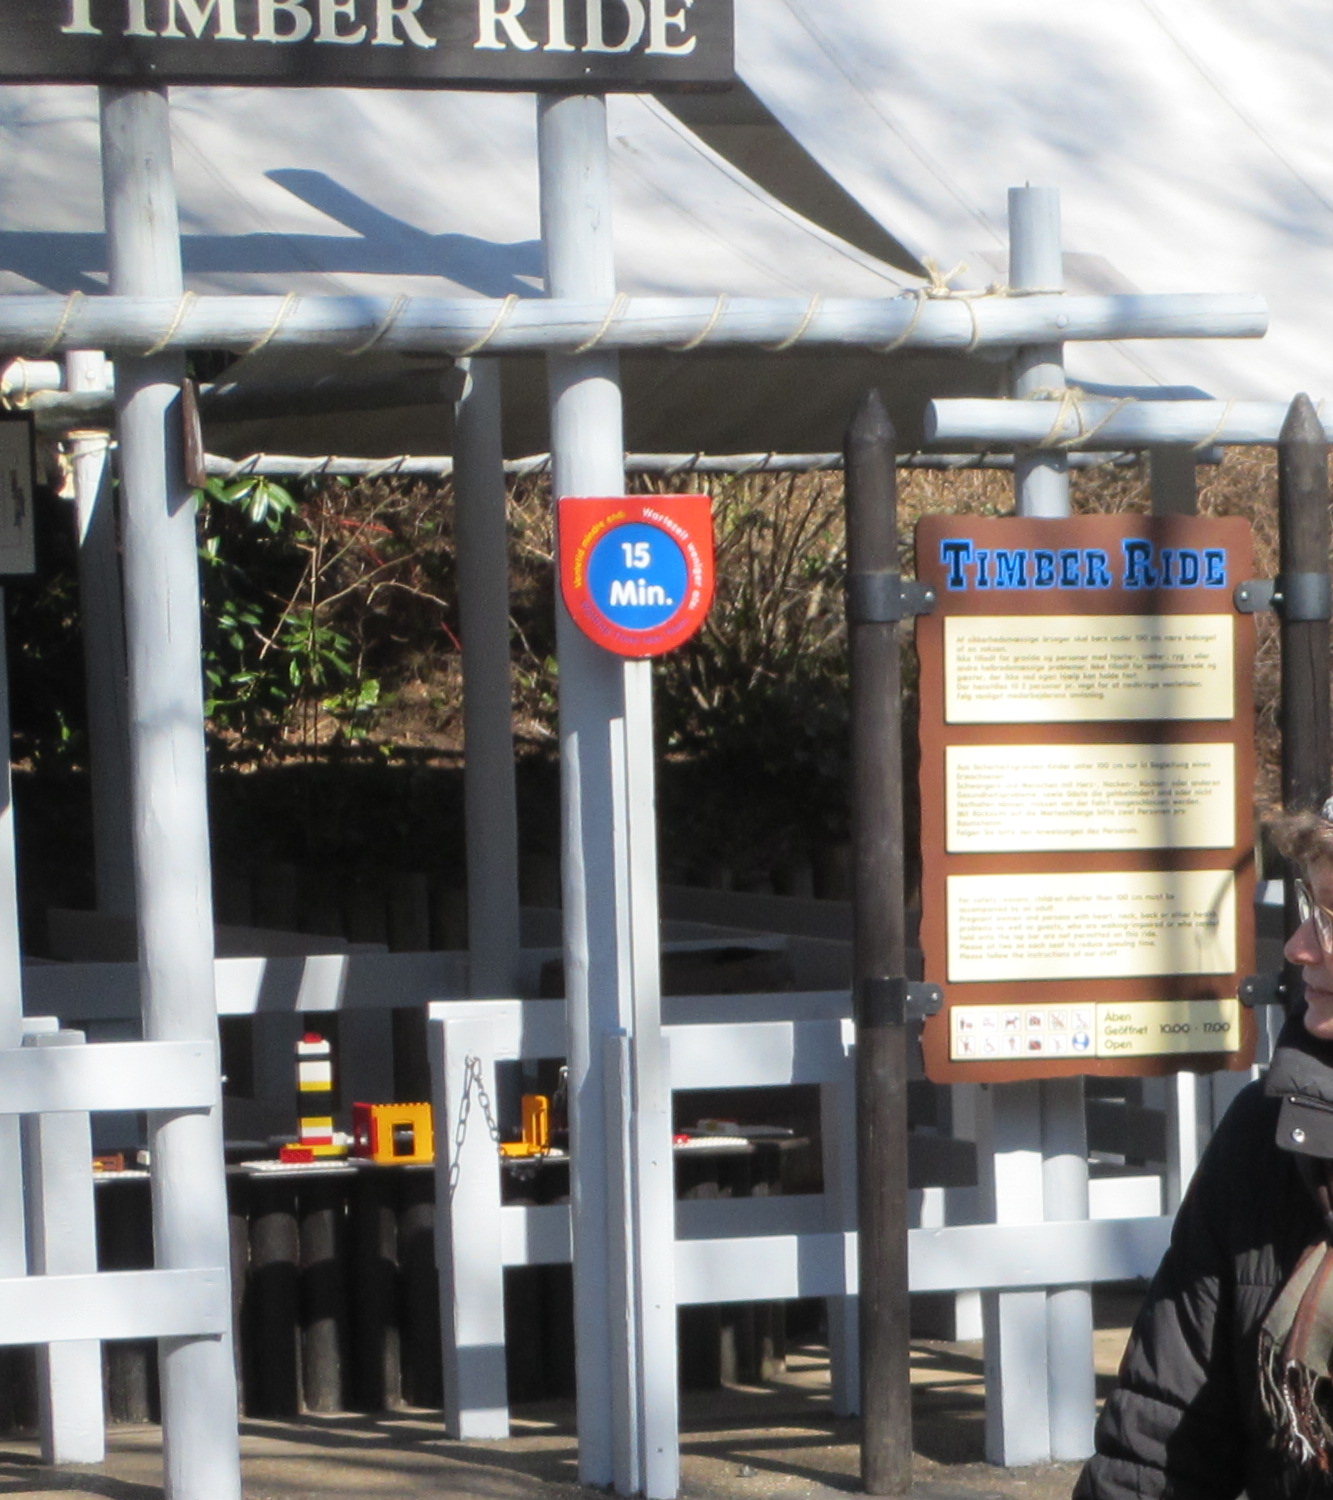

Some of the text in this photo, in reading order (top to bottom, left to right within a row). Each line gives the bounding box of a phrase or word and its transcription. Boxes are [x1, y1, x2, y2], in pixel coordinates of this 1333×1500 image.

[473, 0, 697, 54] RIDE
[621, 541, 651, 569] 15
[642, 507, 690, 541] Wartezeit
[687, 542, 703, 587] weniger
[941, 538, 1227, 590] TIMBER RIDE
[610, 577, 674, 607] Min.
[1104, 1040, 1132, 1051] Open
